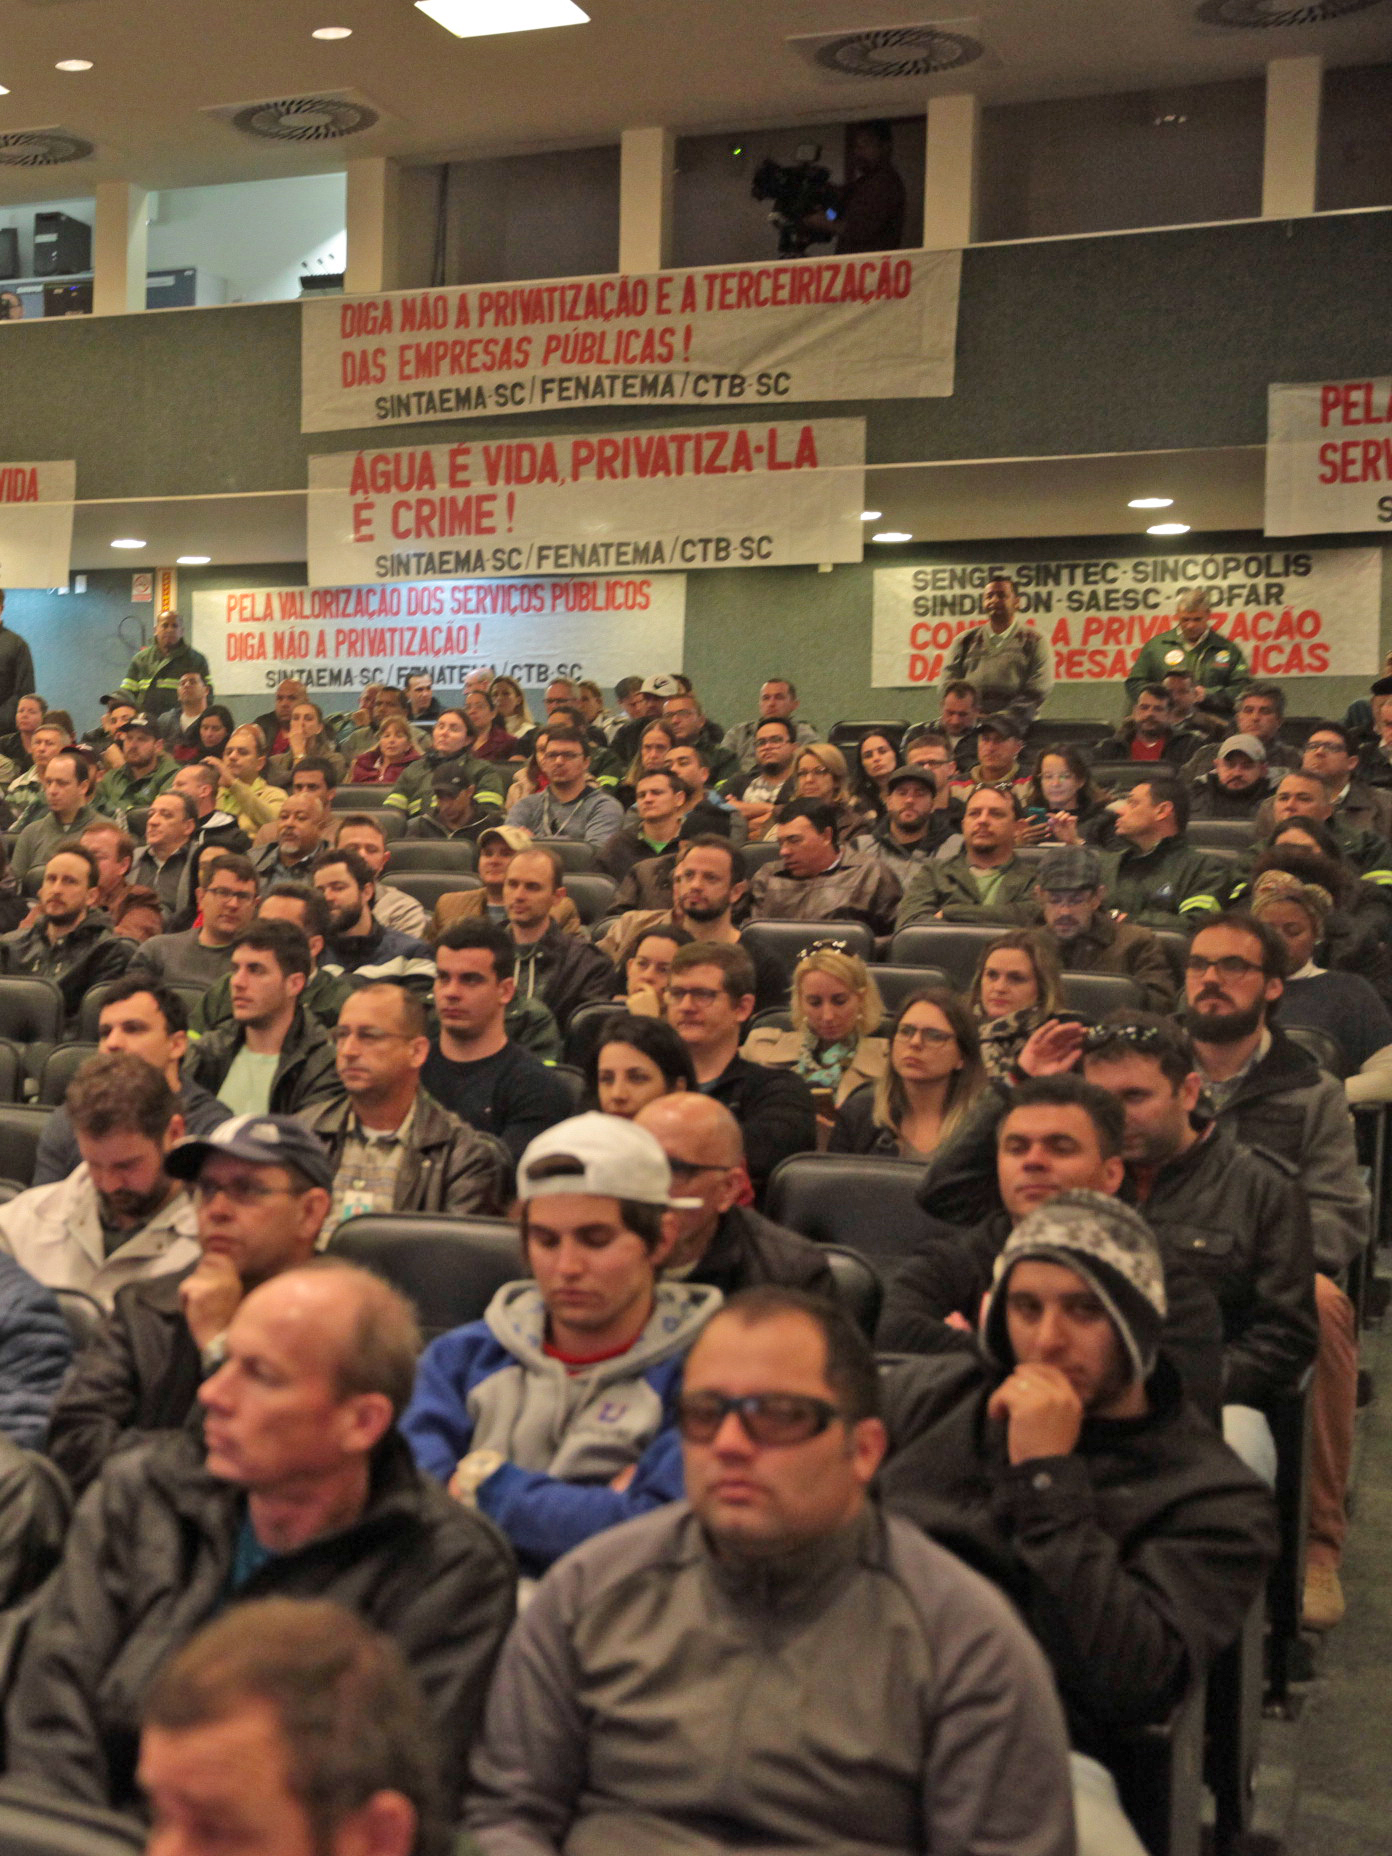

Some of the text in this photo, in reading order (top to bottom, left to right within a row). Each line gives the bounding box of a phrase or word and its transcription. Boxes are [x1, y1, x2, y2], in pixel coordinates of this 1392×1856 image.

[341, 256, 912, 339] DIGA NÃO A PRIVATIZAÇÃO E A TERCEIRIZAÇÃO
[342, 348, 387, 388] DAS
[399, 336, 533, 381] EMPRESAS
[1320, 382, 1392, 427] PEL
[350, 450, 436, 496] ÁGUA
[449, 442, 471, 489] É
[483, 442, 566, 487] VIDA,
[353, 497, 375, 543] É
[226, 578, 652, 623] PELA VALORIZAÇÃO DOS SERVIÇOS PÚBLICOS
[226, 630, 267, 662] DIGA
[273, 626, 309, 660] NÃO
[314, 629, 327, 658] A
[1051, 617, 1071, 647] A
[908, 654, 944, 683] DA
